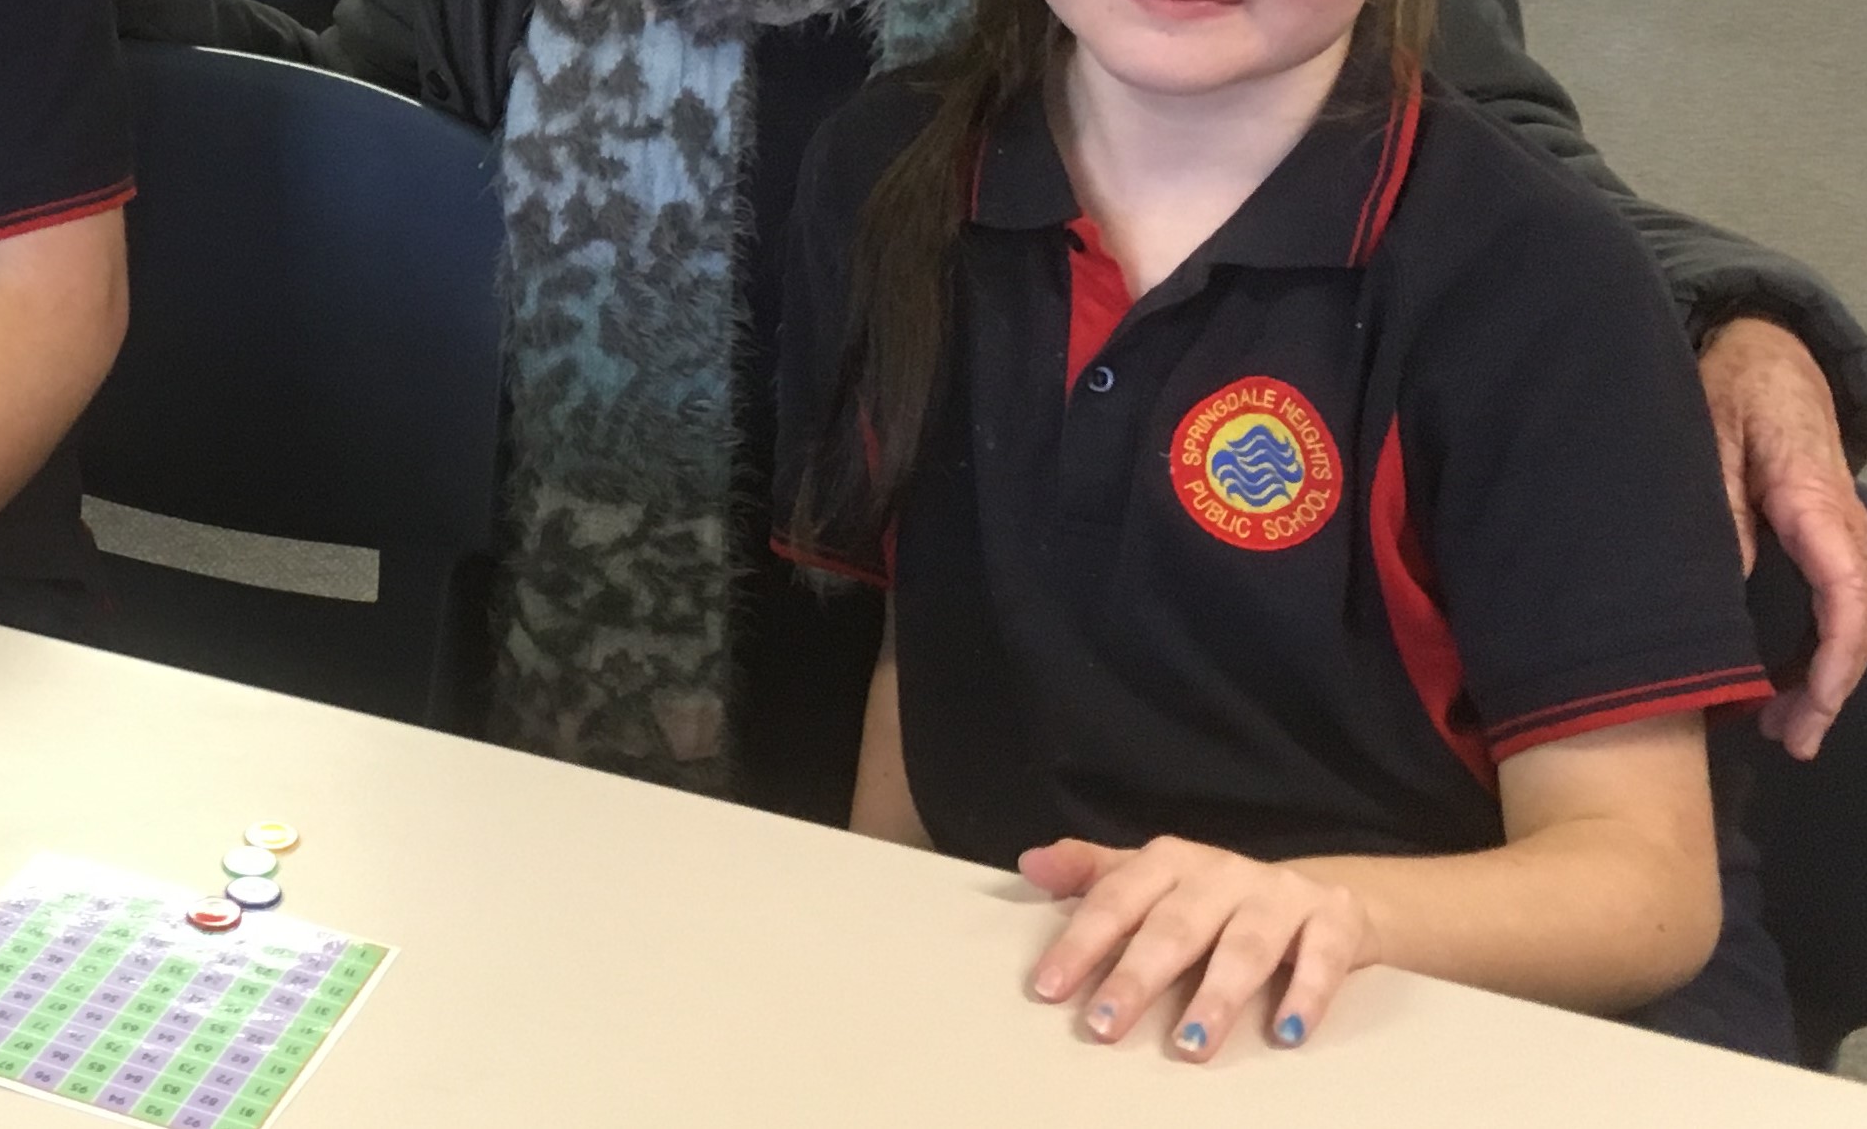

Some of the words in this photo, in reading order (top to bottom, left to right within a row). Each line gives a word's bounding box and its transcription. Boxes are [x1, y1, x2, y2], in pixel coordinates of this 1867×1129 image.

[1182, 387, 1277, 466] SPRINGDALE
[1279, 397, 1332, 481] HEIGHTS
[1184, 479, 1252, 539] PUBLIC
[1262, 488, 1331, 541] SCHOOL
